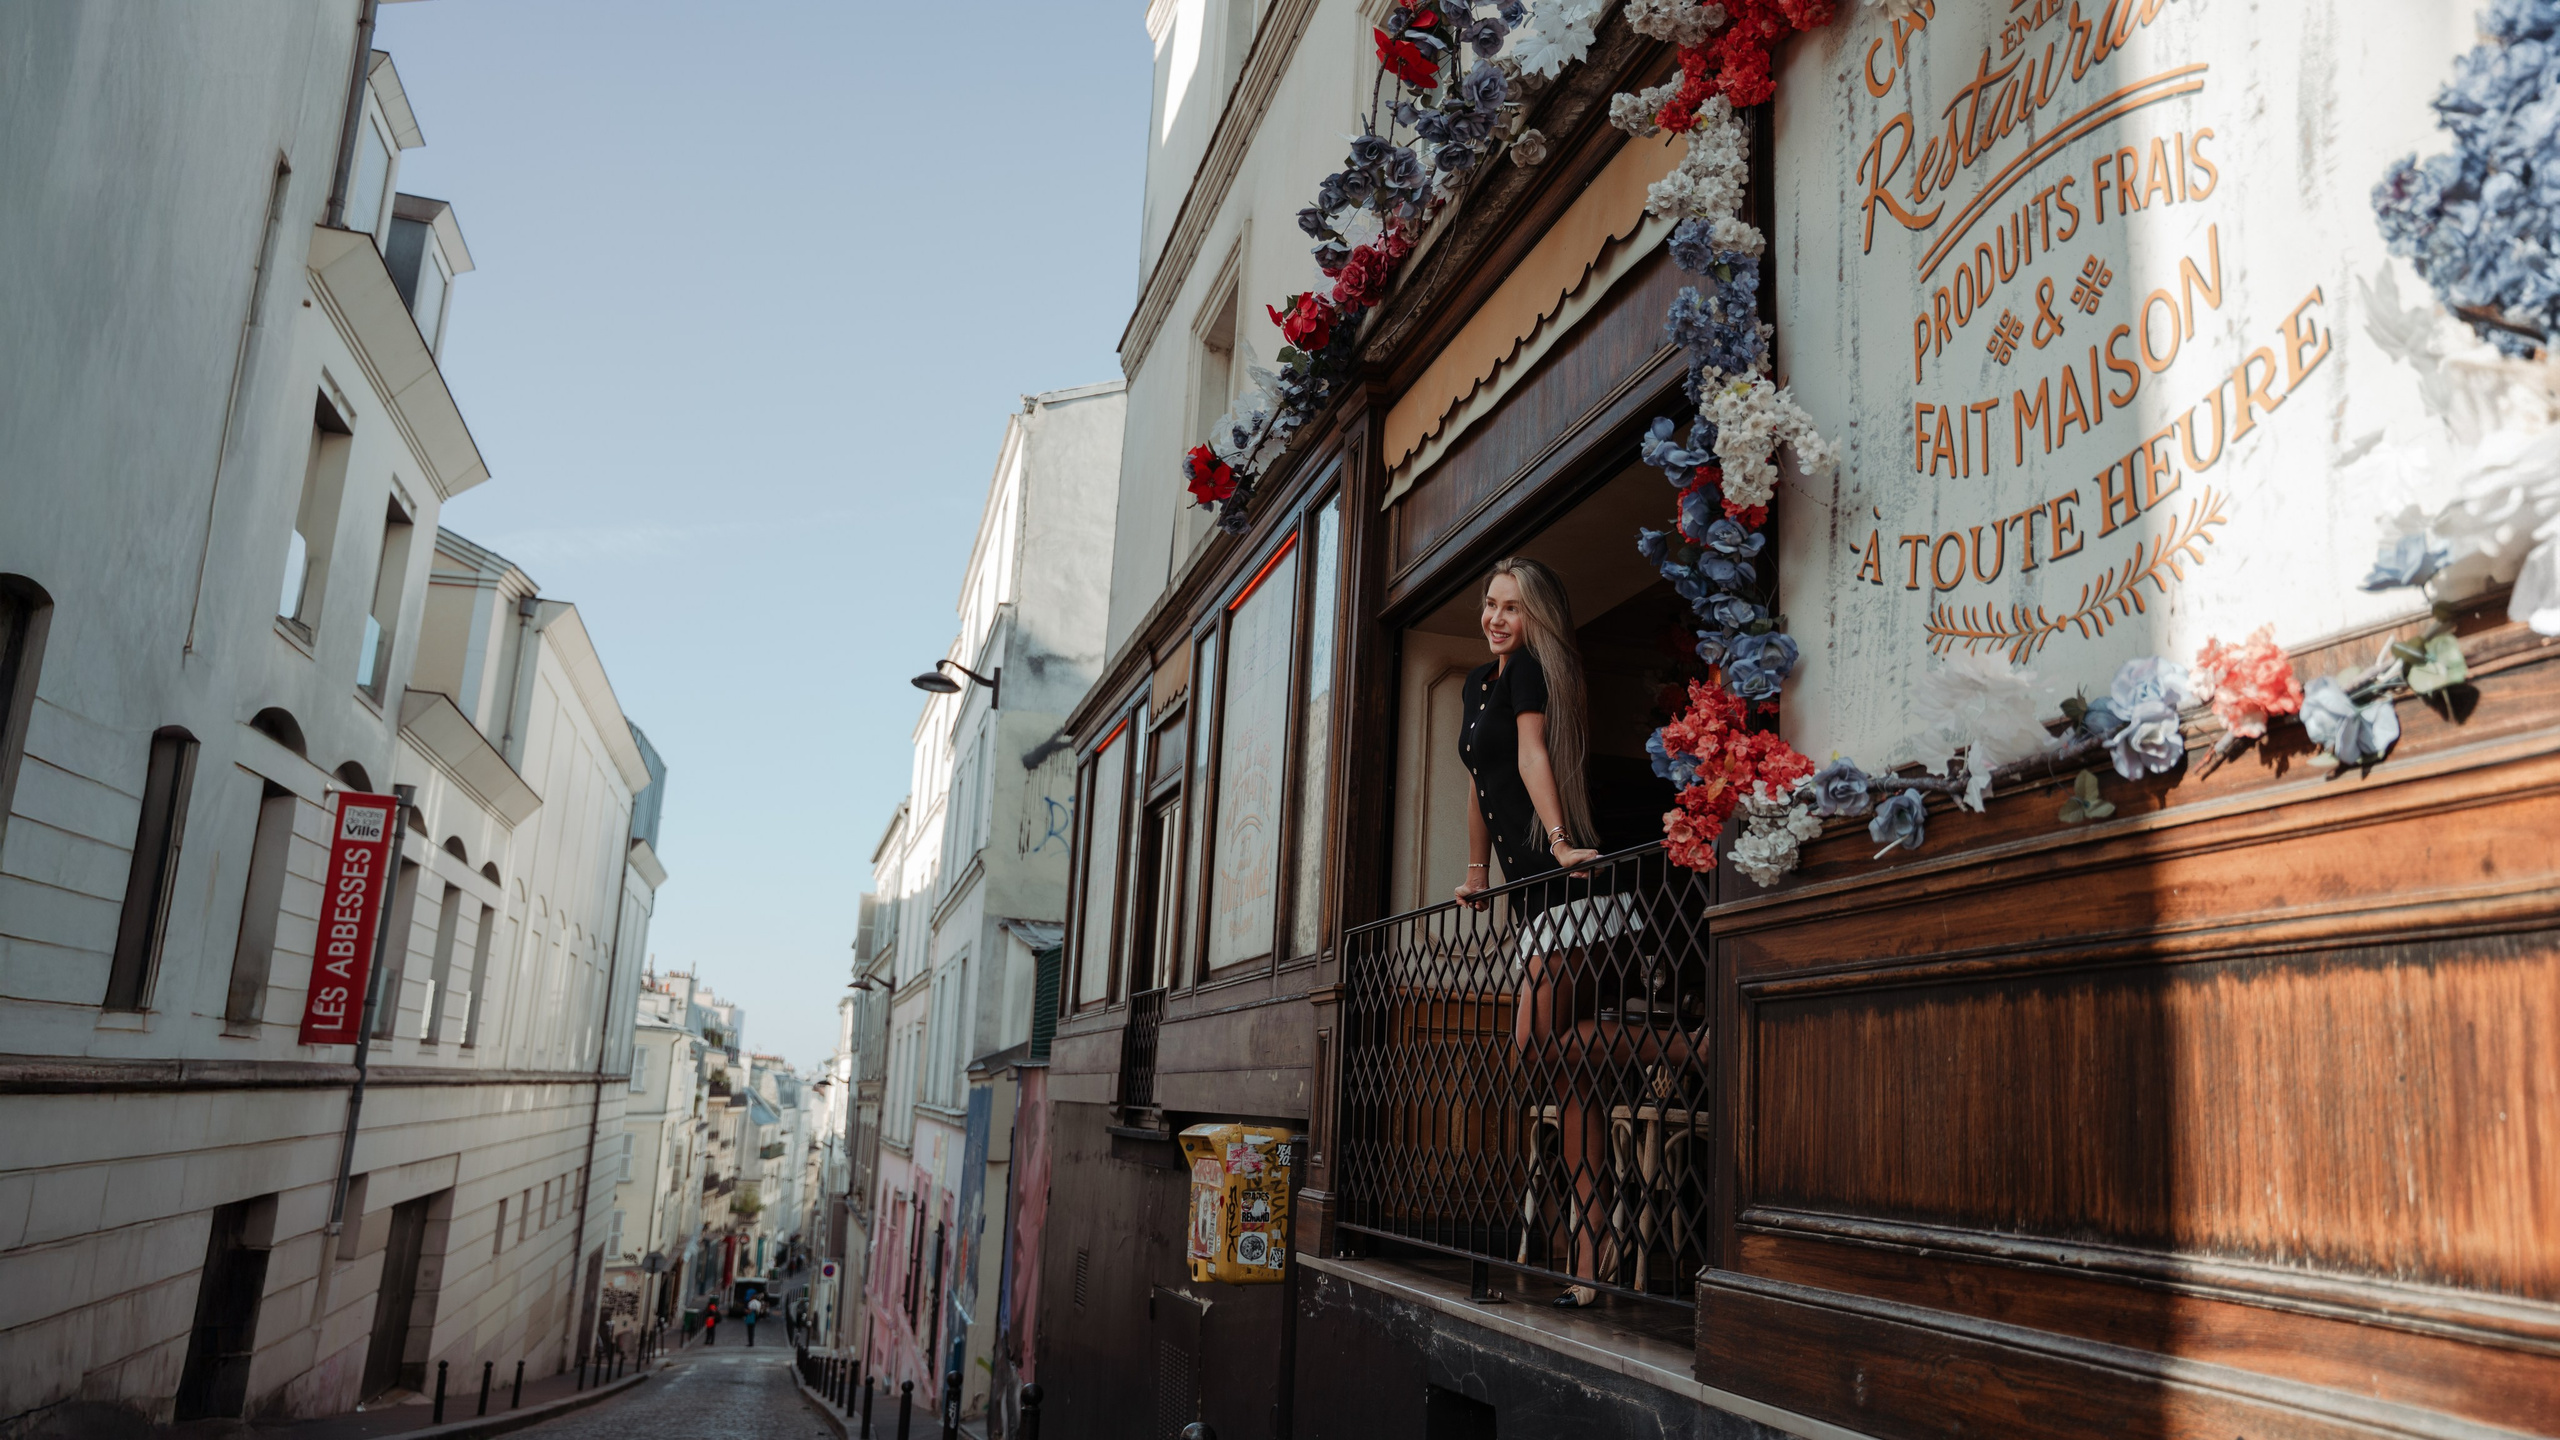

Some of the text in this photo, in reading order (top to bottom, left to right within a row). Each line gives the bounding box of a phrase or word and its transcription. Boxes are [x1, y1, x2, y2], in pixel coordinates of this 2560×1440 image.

[1912, 126, 2219, 386] PRODUITS FRAIS
[1914, 223, 2224, 479] FAIT MAISON
[2031, 276, 2065, 350] &
[1899, 489, 2085, 592] TOUTE
[2094, 285, 2333, 539] HEURE
[312, 848, 372, 1031] LES ABBESSES
[346, 823, 380, 838] Ville
